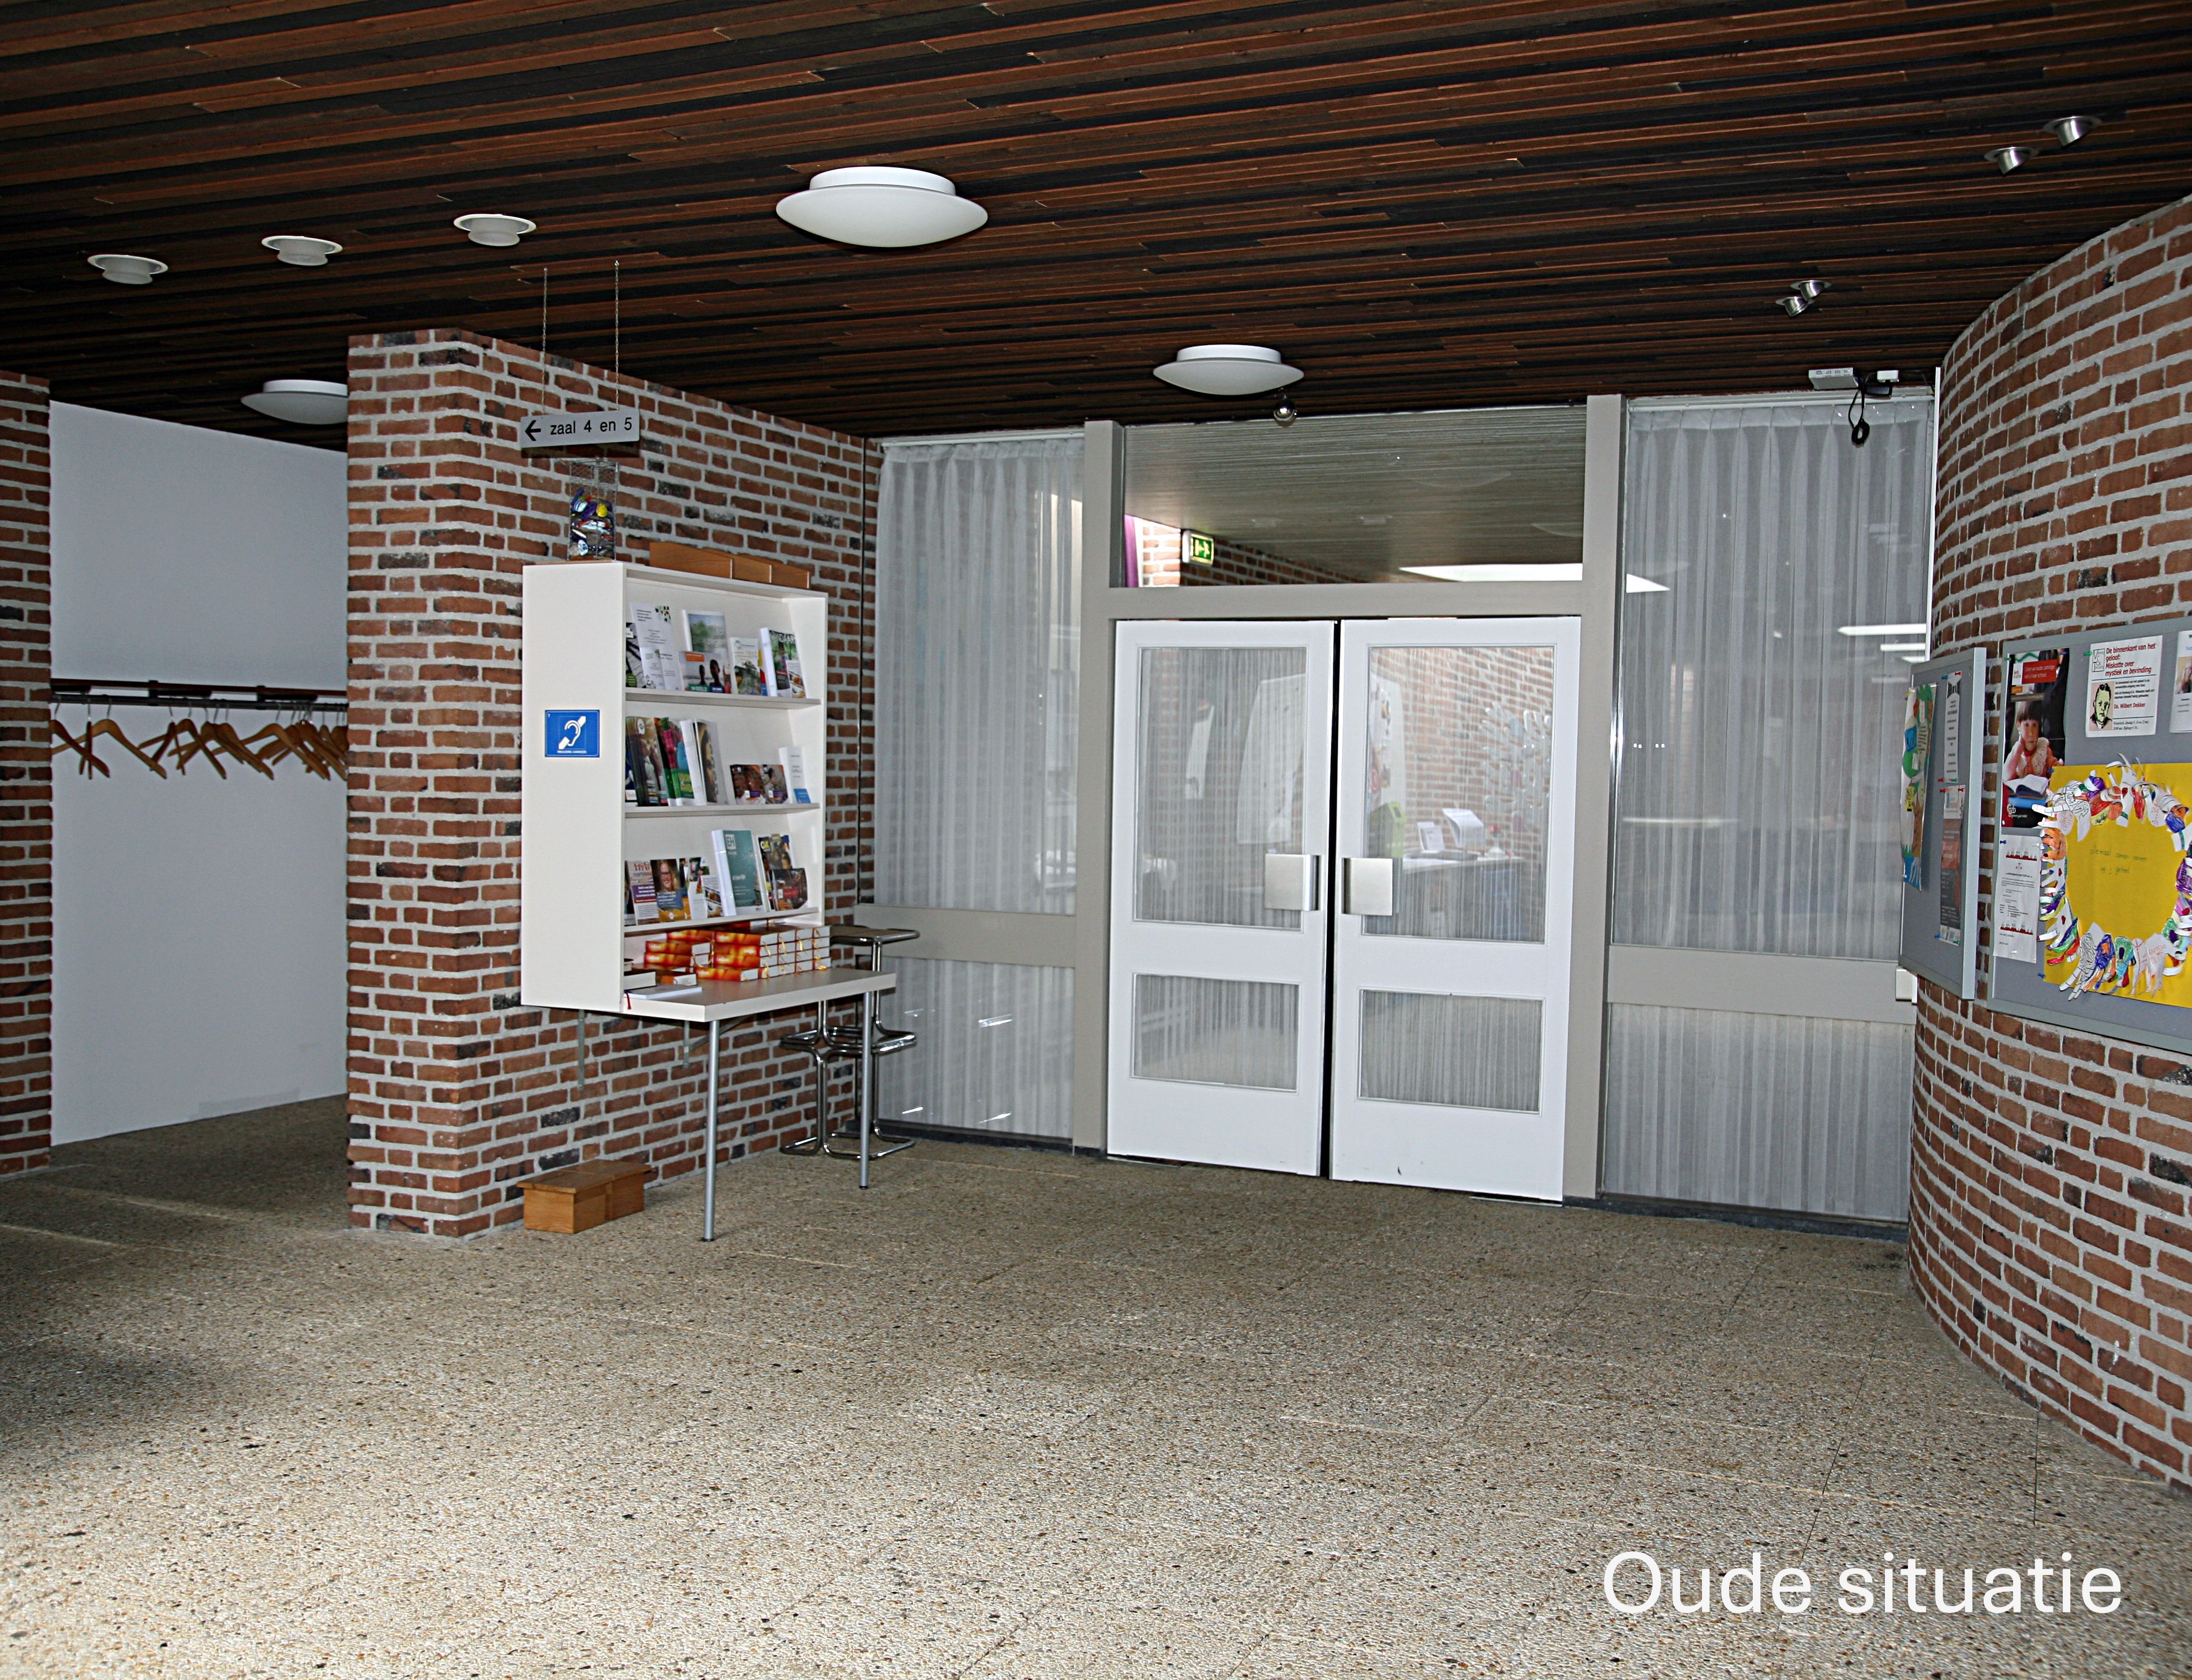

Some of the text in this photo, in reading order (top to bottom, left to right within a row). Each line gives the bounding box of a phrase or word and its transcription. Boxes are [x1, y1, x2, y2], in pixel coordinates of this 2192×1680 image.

[550, 417, 633, 435] zaal 4 en 5
[2113, 645, 2137, 653] binnenkant
